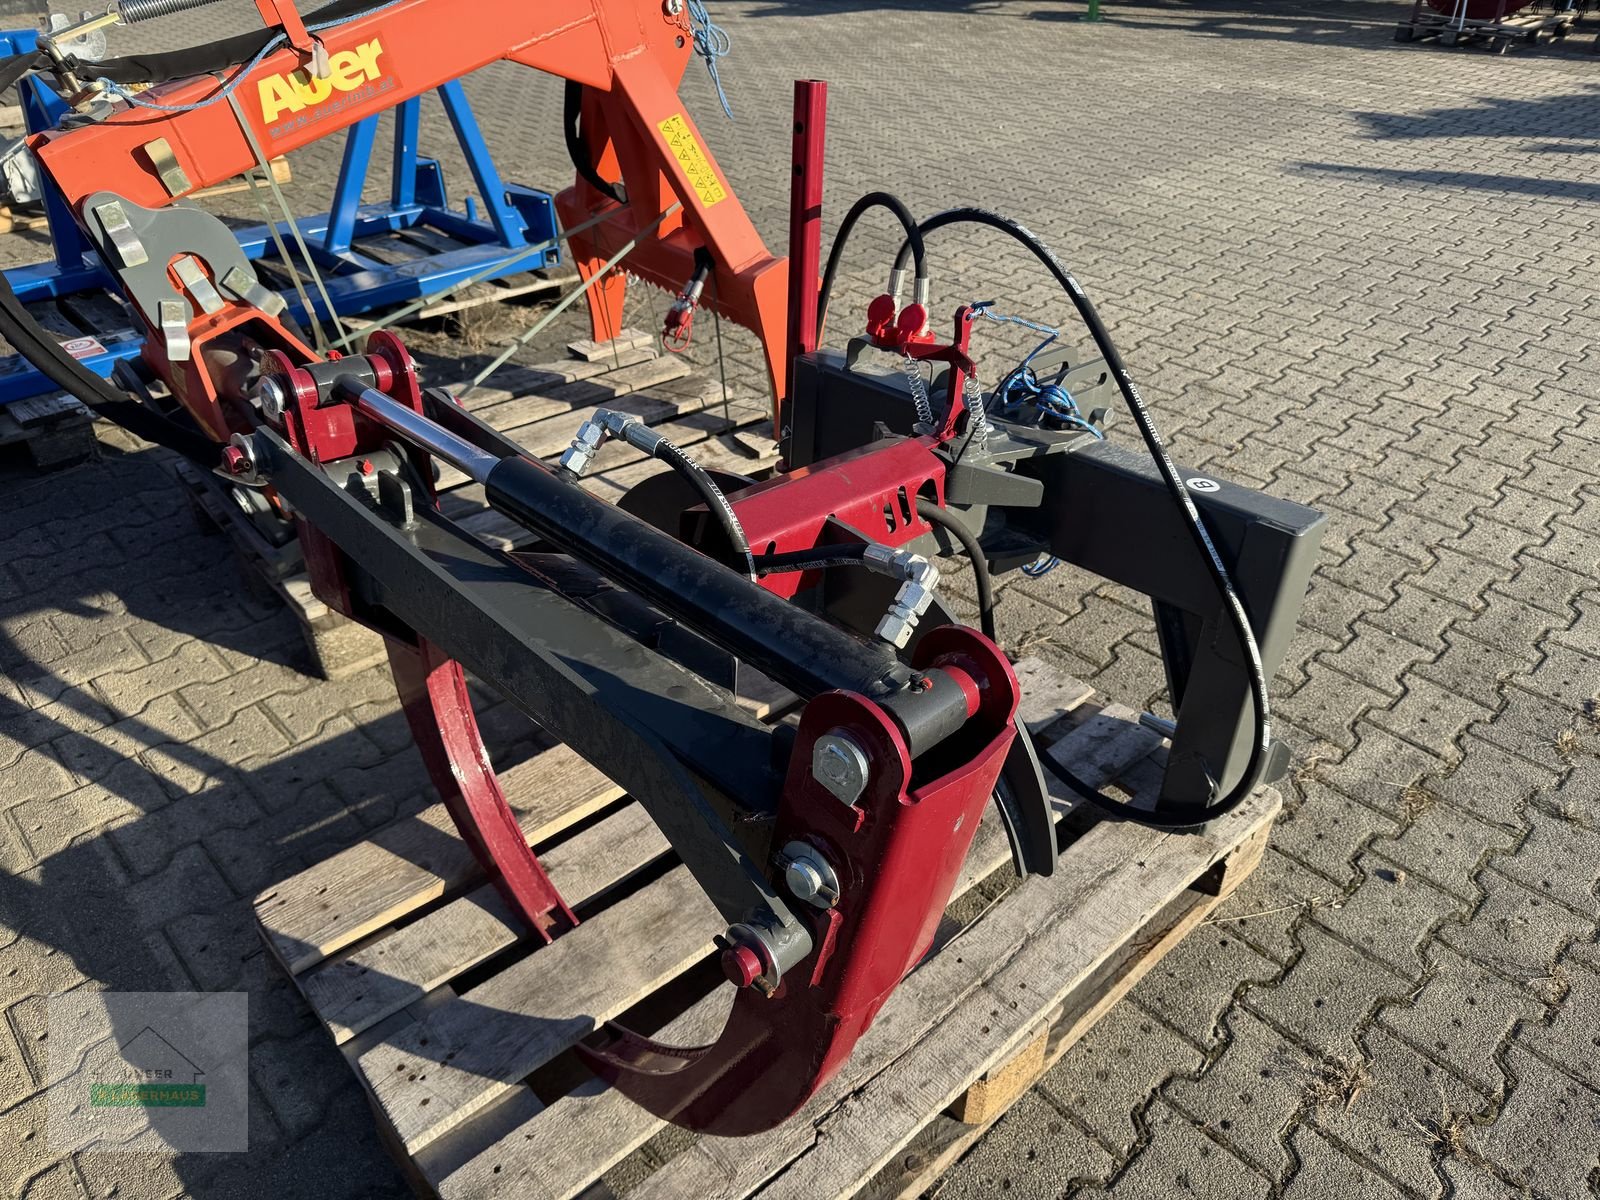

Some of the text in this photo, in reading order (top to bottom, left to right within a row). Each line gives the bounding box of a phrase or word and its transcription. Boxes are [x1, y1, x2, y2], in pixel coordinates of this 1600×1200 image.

[257, 38, 383, 124] Auer
[1128, 382, 1163, 443] NORTH FIGHTER
